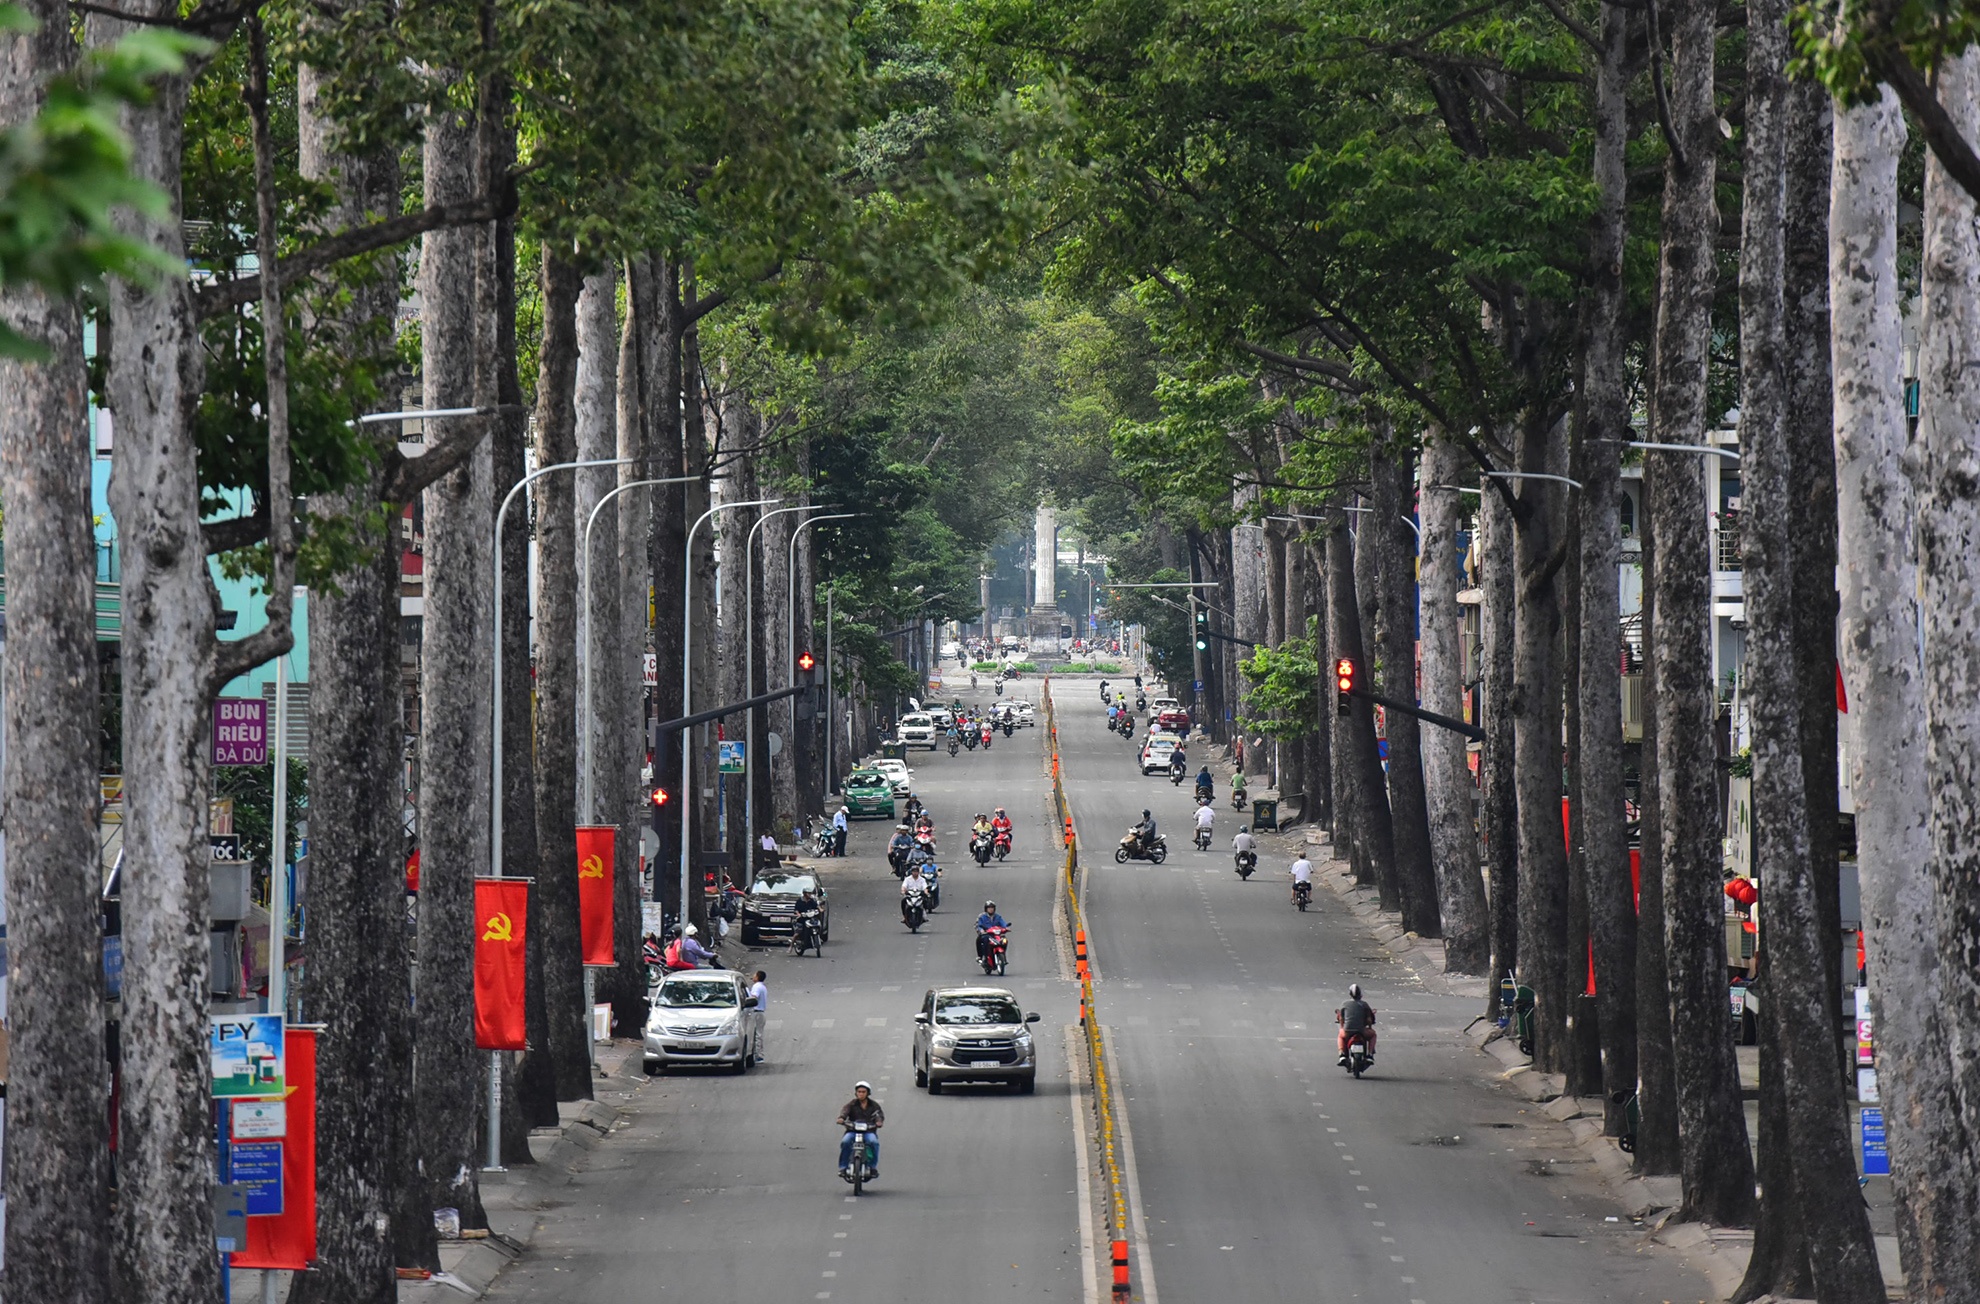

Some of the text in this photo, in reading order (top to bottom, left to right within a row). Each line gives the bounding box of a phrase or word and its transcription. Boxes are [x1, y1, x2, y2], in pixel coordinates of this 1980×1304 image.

[1196, 681, 1203, 689] P
[221, 701, 260, 720] BÚN
[218, 723, 262, 742] RIÊU
[216, 743, 238, 762] BÀ
